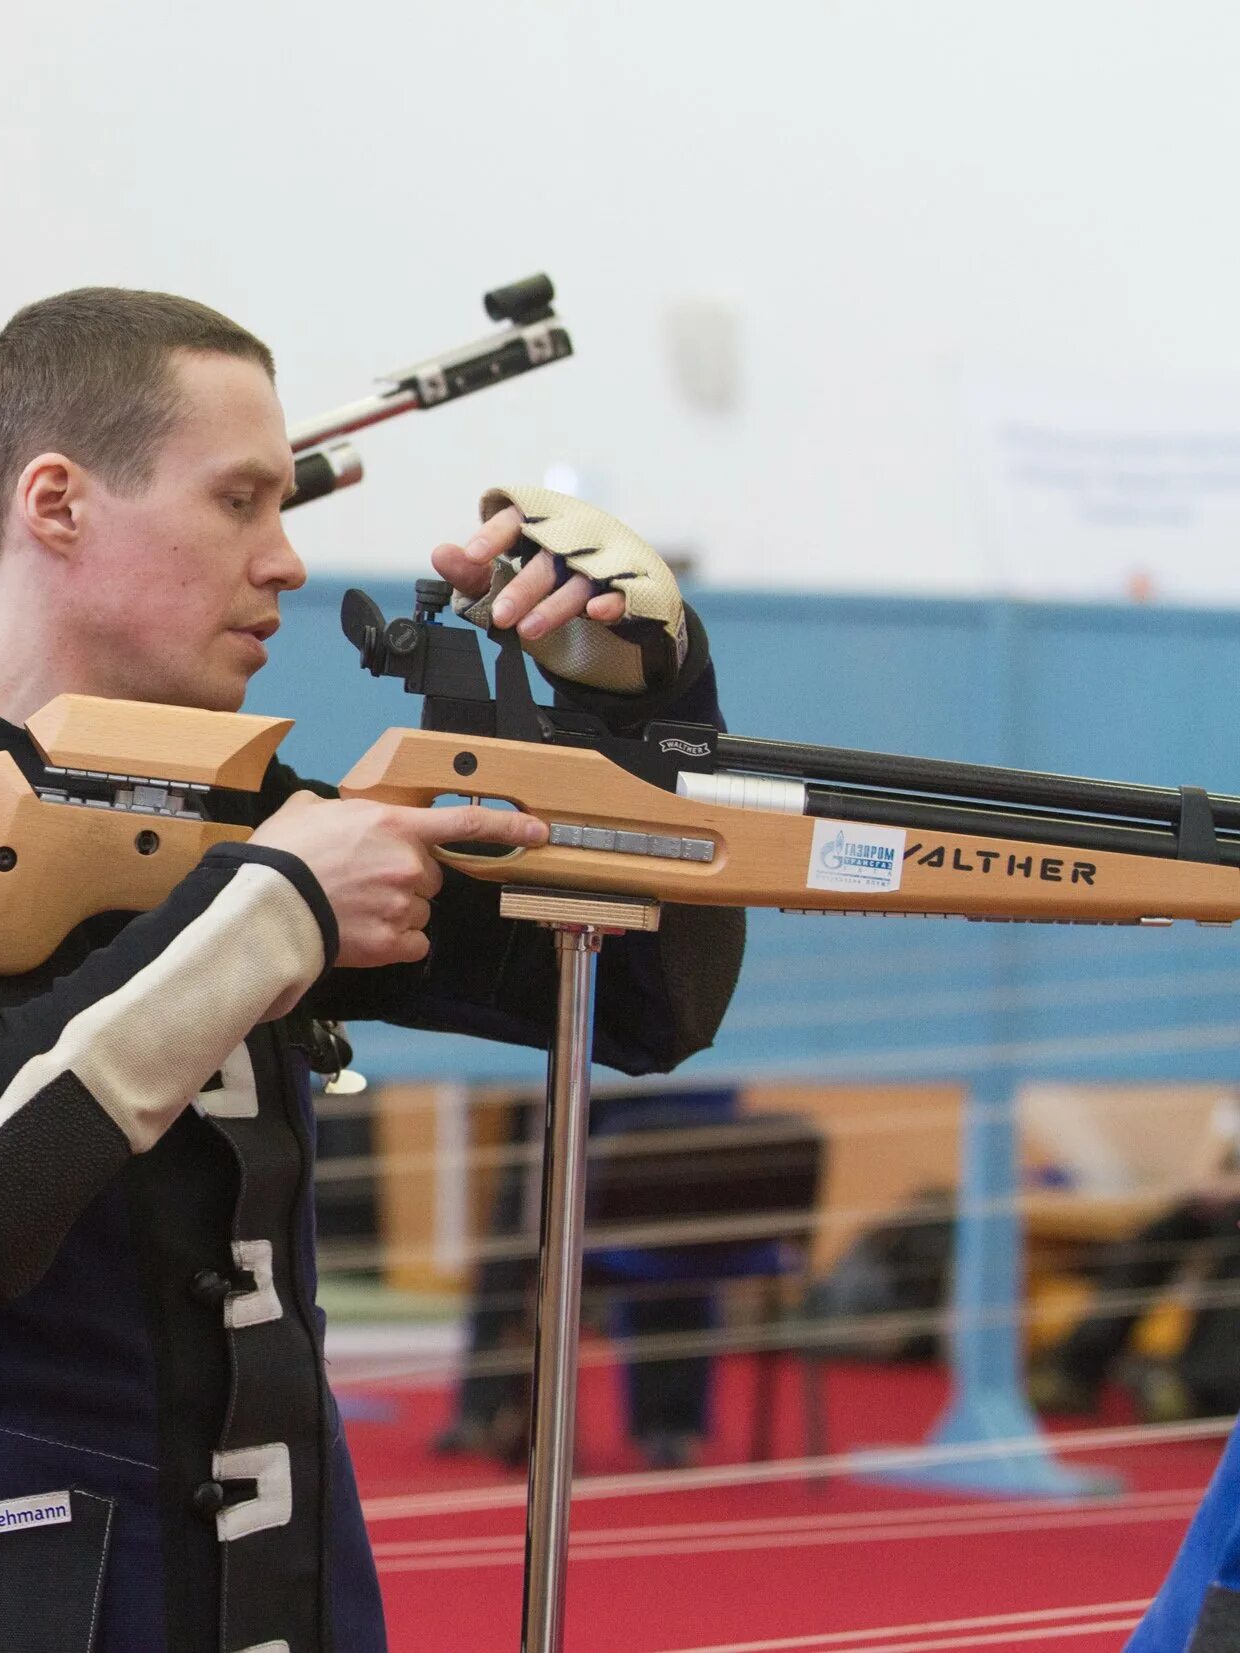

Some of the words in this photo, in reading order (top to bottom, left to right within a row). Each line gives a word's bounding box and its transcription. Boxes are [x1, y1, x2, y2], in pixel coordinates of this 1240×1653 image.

[666, 741, 704, 754] WALTHER
[844, 842, 895, 861] ГАЗПРОМ
[844, 857, 893, 870] ТРАНСГАЗ
